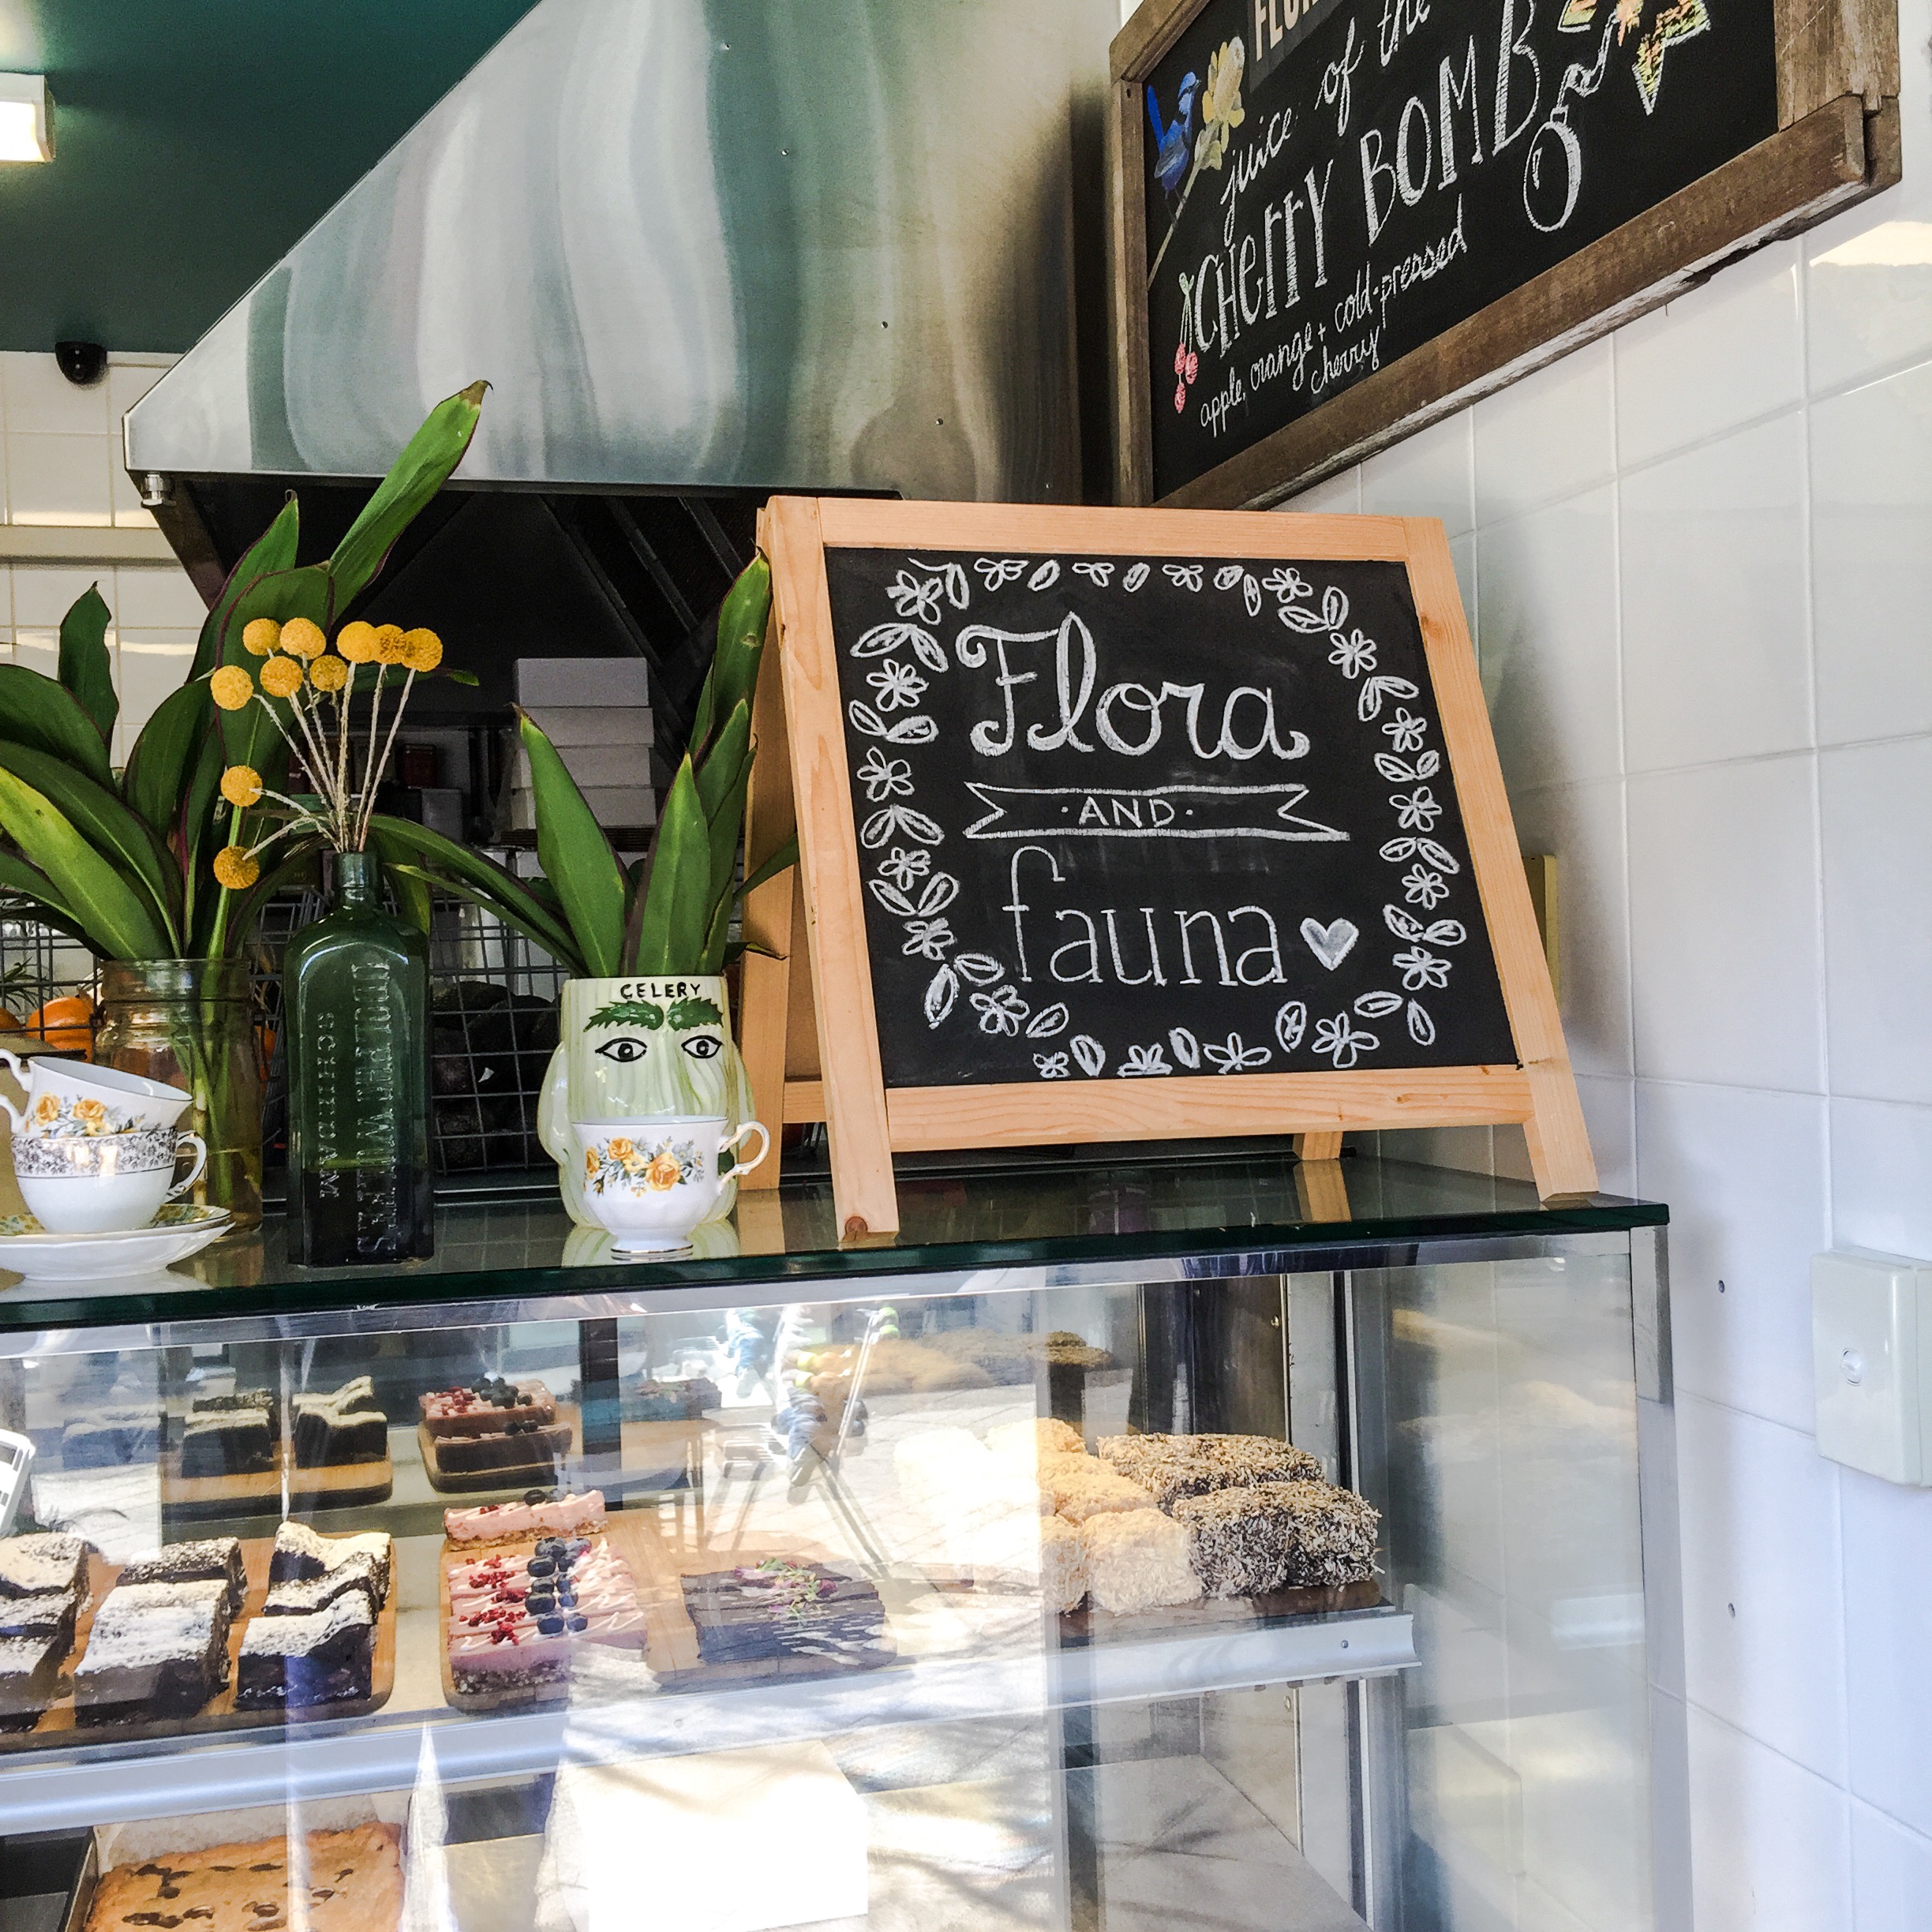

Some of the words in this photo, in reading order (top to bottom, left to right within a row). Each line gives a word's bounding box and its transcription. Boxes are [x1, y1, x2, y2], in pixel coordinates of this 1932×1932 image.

[1220, 107, 1292, 247] juice
[1314, 17, 1367, 137] of
[1360, 0, 1540, 247] BOMB
[1250, 321, 1313, 391] orange
[1310, 325, 1380, 395] cherry
[956, 610, 1311, 760] Flora
[1002, 846, 1288, 987] fauna
[620, 981, 701, 1000] CELERY
